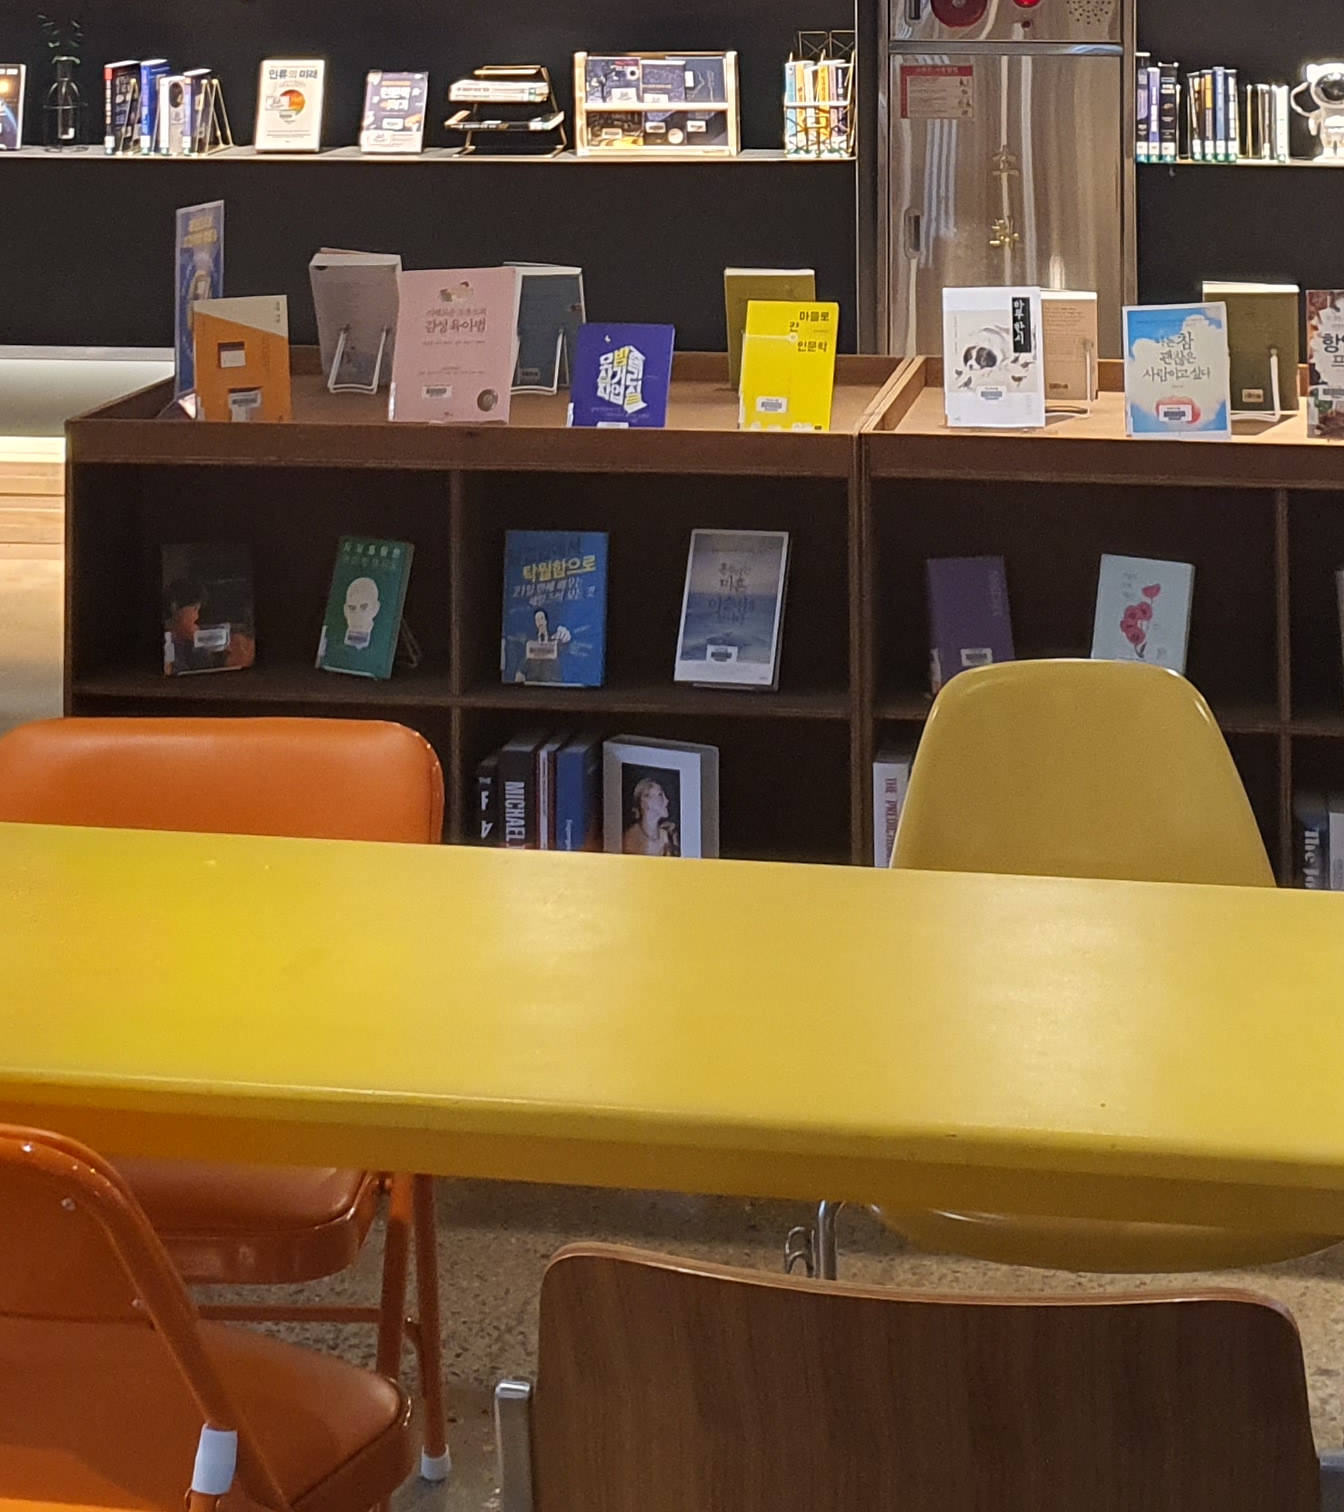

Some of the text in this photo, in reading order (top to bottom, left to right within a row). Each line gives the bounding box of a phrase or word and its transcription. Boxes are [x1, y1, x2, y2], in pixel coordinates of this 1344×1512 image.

[269, 69, 318, 80] 인류의 미래
[799, 311, 830, 322] 마을로
[789, 321, 800, 333] 간
[797, 340, 828, 353] 인문학
[1176, 331, 1194, 350] 참
[1160, 349, 1197, 366] 괜찮은
[1142, 366, 1211, 383] 사람이고 싶다
[522, 555, 597, 583] 탁월함으로
[503, 780, 526, 843] MICHAEL
